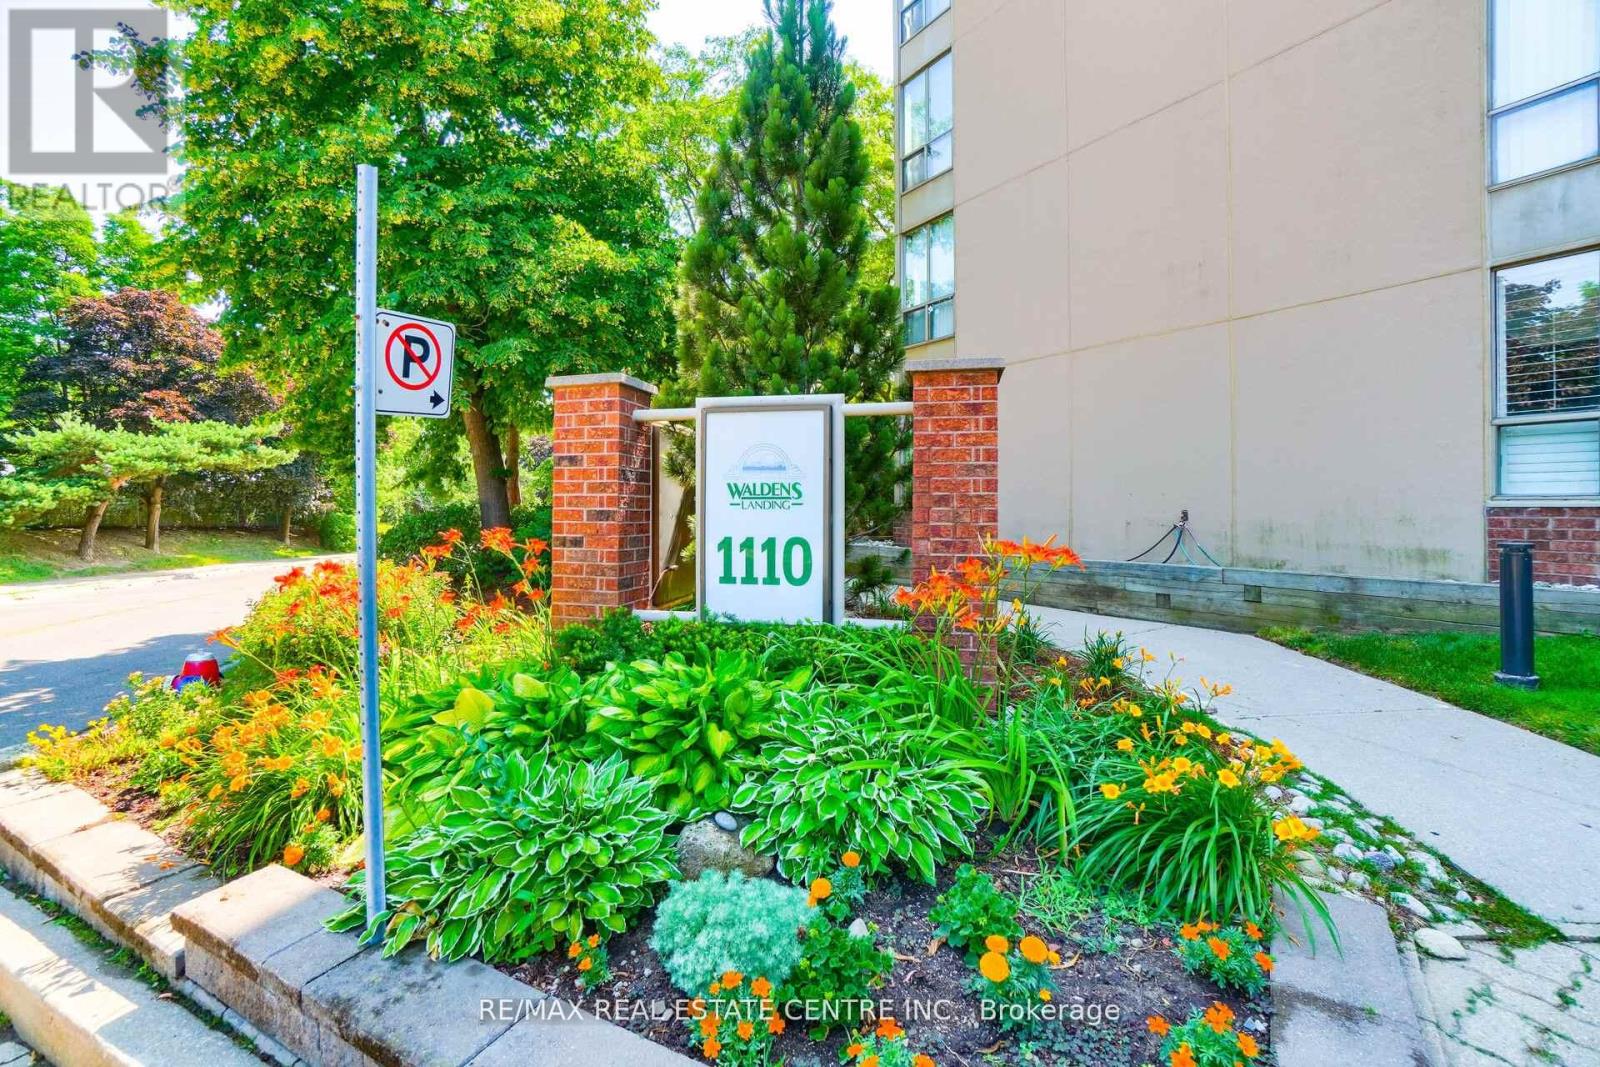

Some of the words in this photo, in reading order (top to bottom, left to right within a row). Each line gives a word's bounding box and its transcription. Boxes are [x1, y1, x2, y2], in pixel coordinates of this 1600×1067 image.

[402, 335, 430, 378] P
[726, 482, 803, 500] WALDENS
[741, 501, 790, 510] LANDING
[717, 536, 812, 586] 1110
